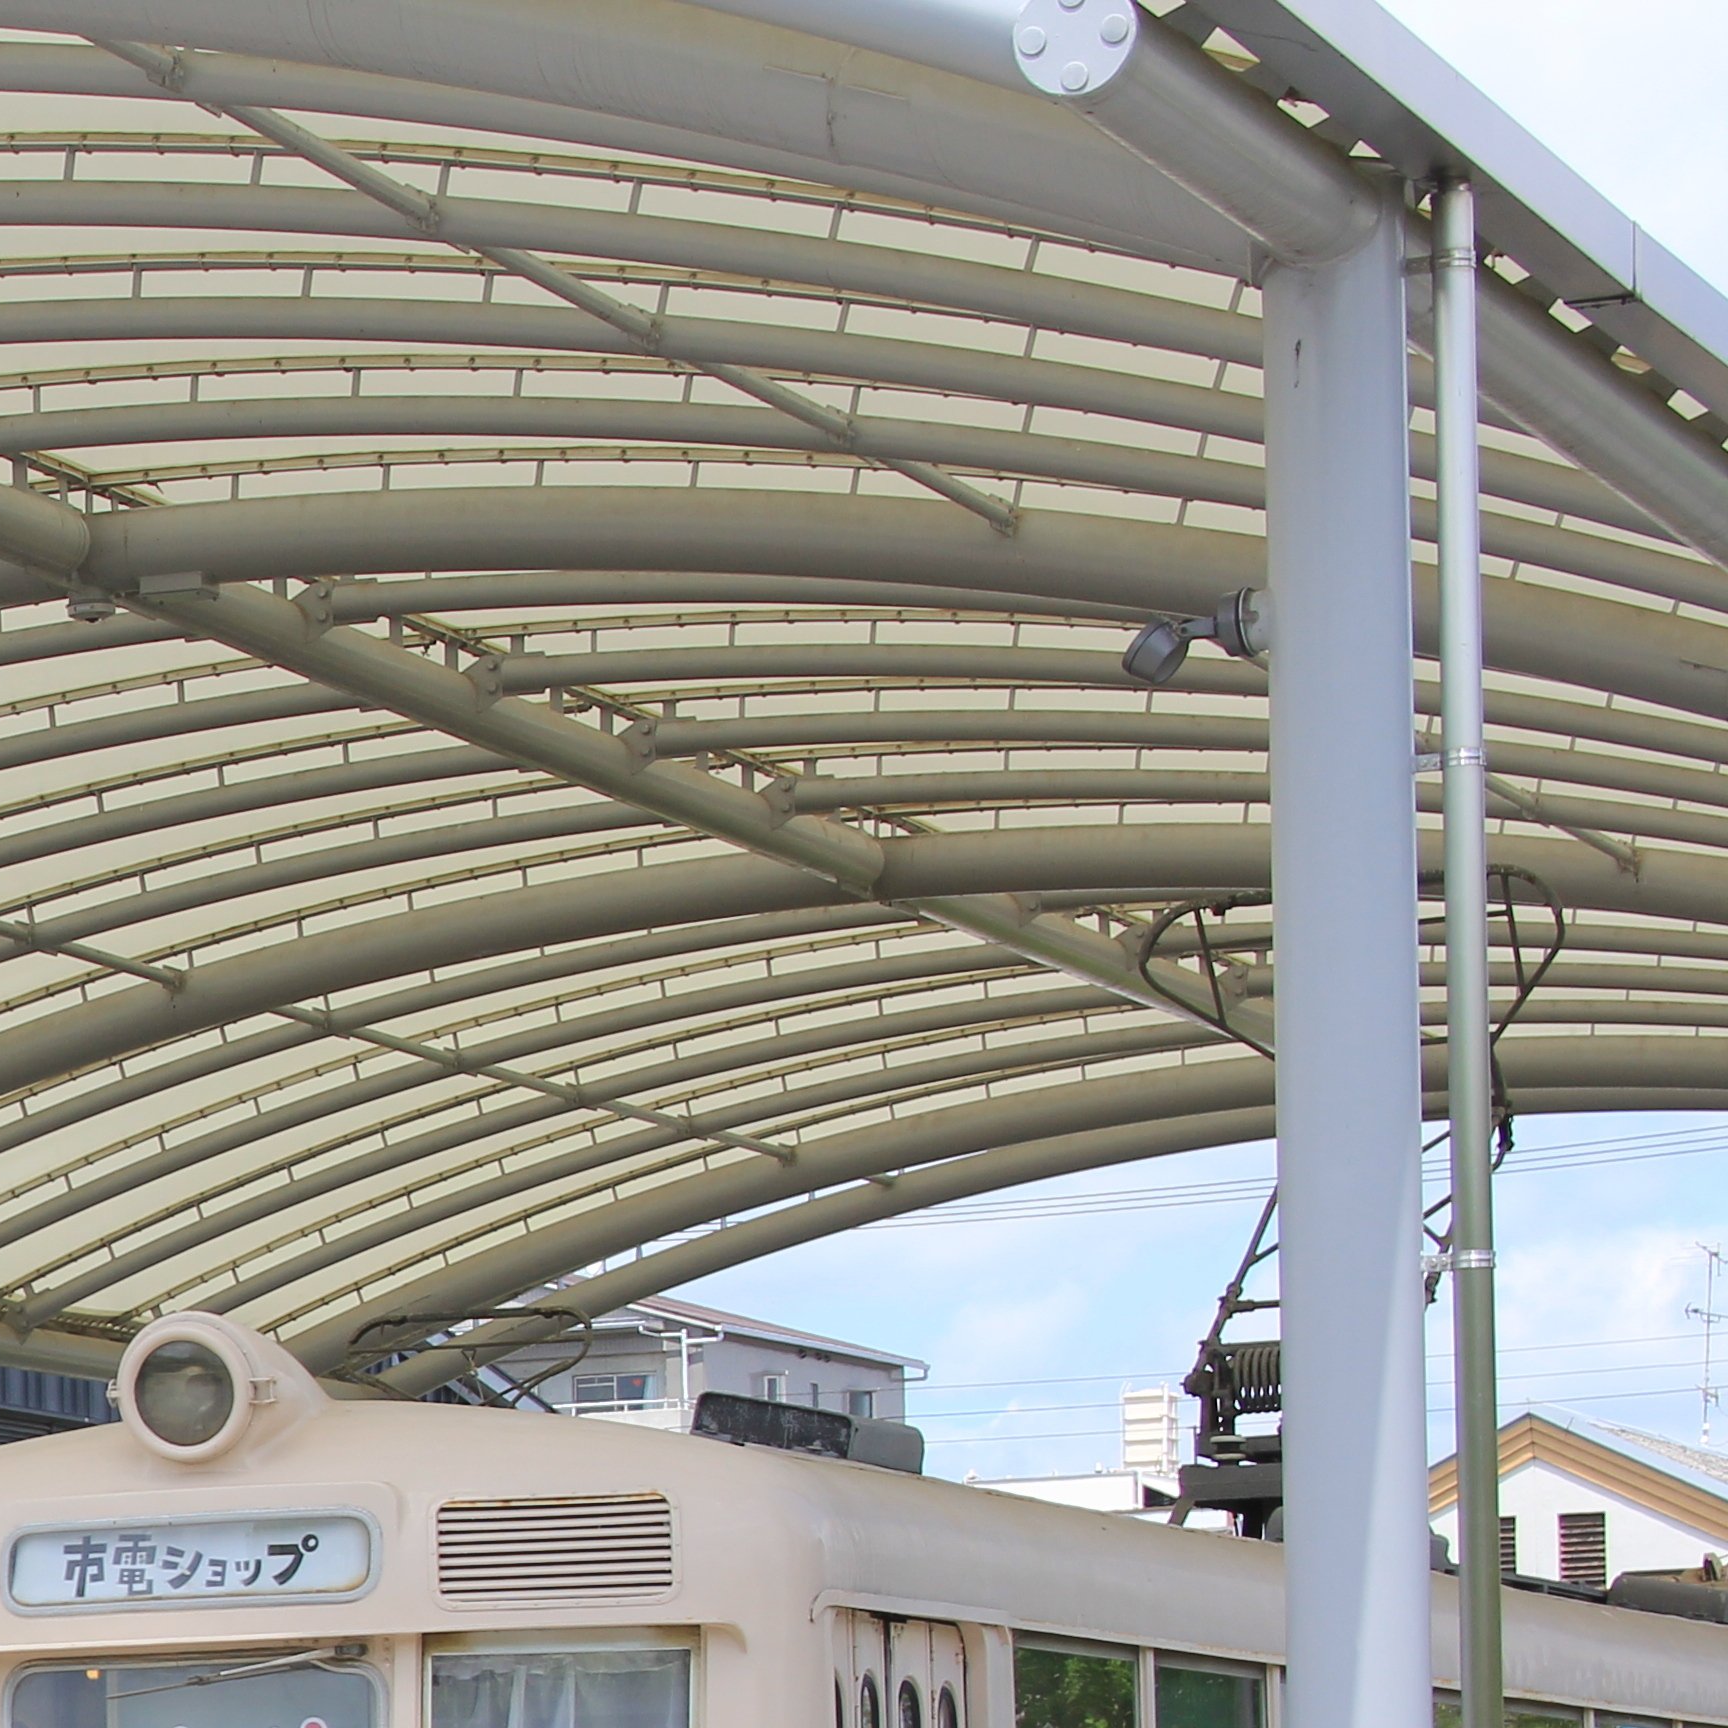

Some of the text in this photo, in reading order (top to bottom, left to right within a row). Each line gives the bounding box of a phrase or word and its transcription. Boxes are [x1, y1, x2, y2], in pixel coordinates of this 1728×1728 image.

[63, 1533, 319, 1598] 市電ショップ
